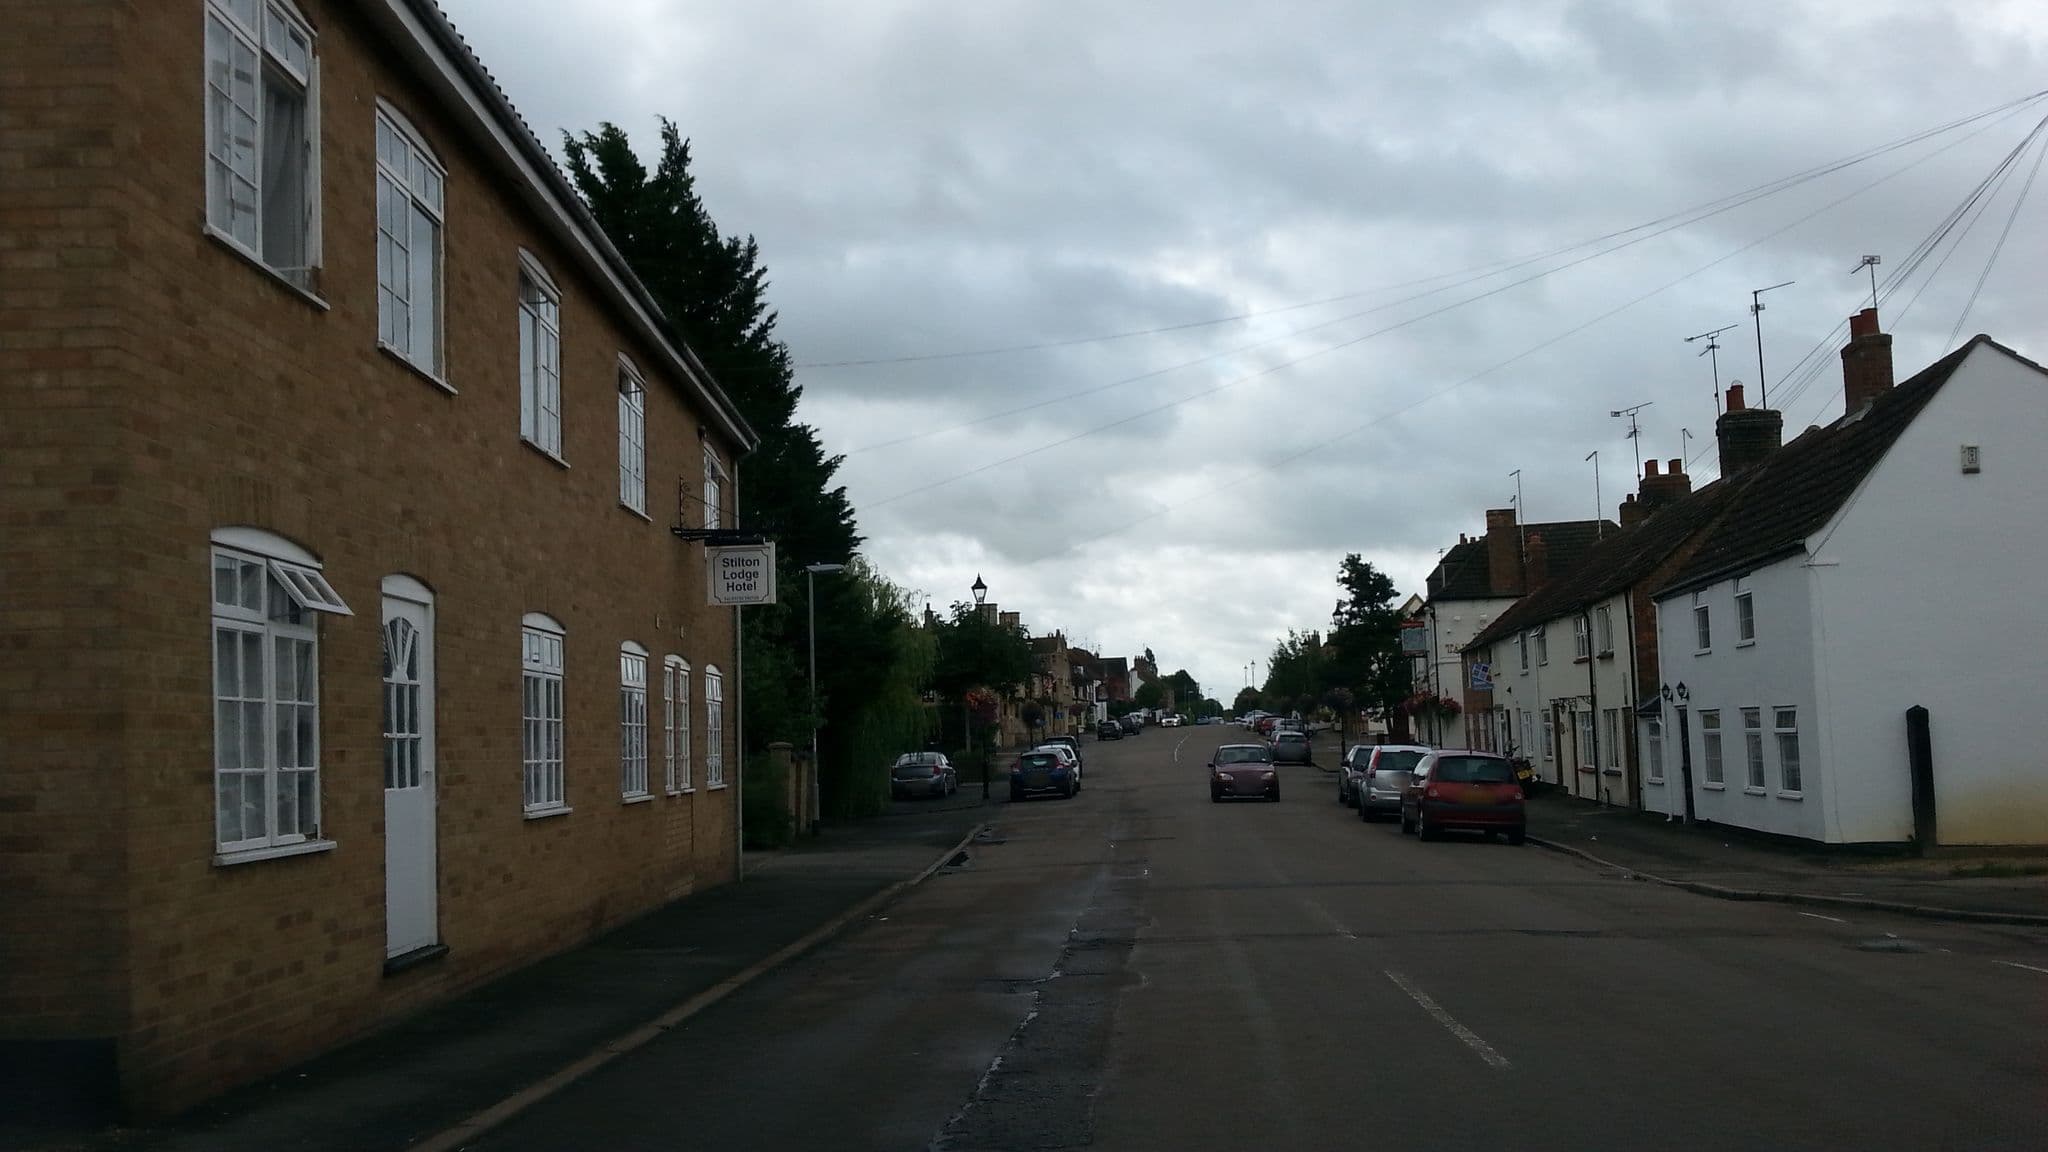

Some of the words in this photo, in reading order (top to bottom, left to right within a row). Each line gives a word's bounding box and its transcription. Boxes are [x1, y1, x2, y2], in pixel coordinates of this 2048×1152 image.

[722, 557, 760, 568] Stilton
[723, 569, 759, 581] Lodge
[726, 580, 757, 592] Hotel
